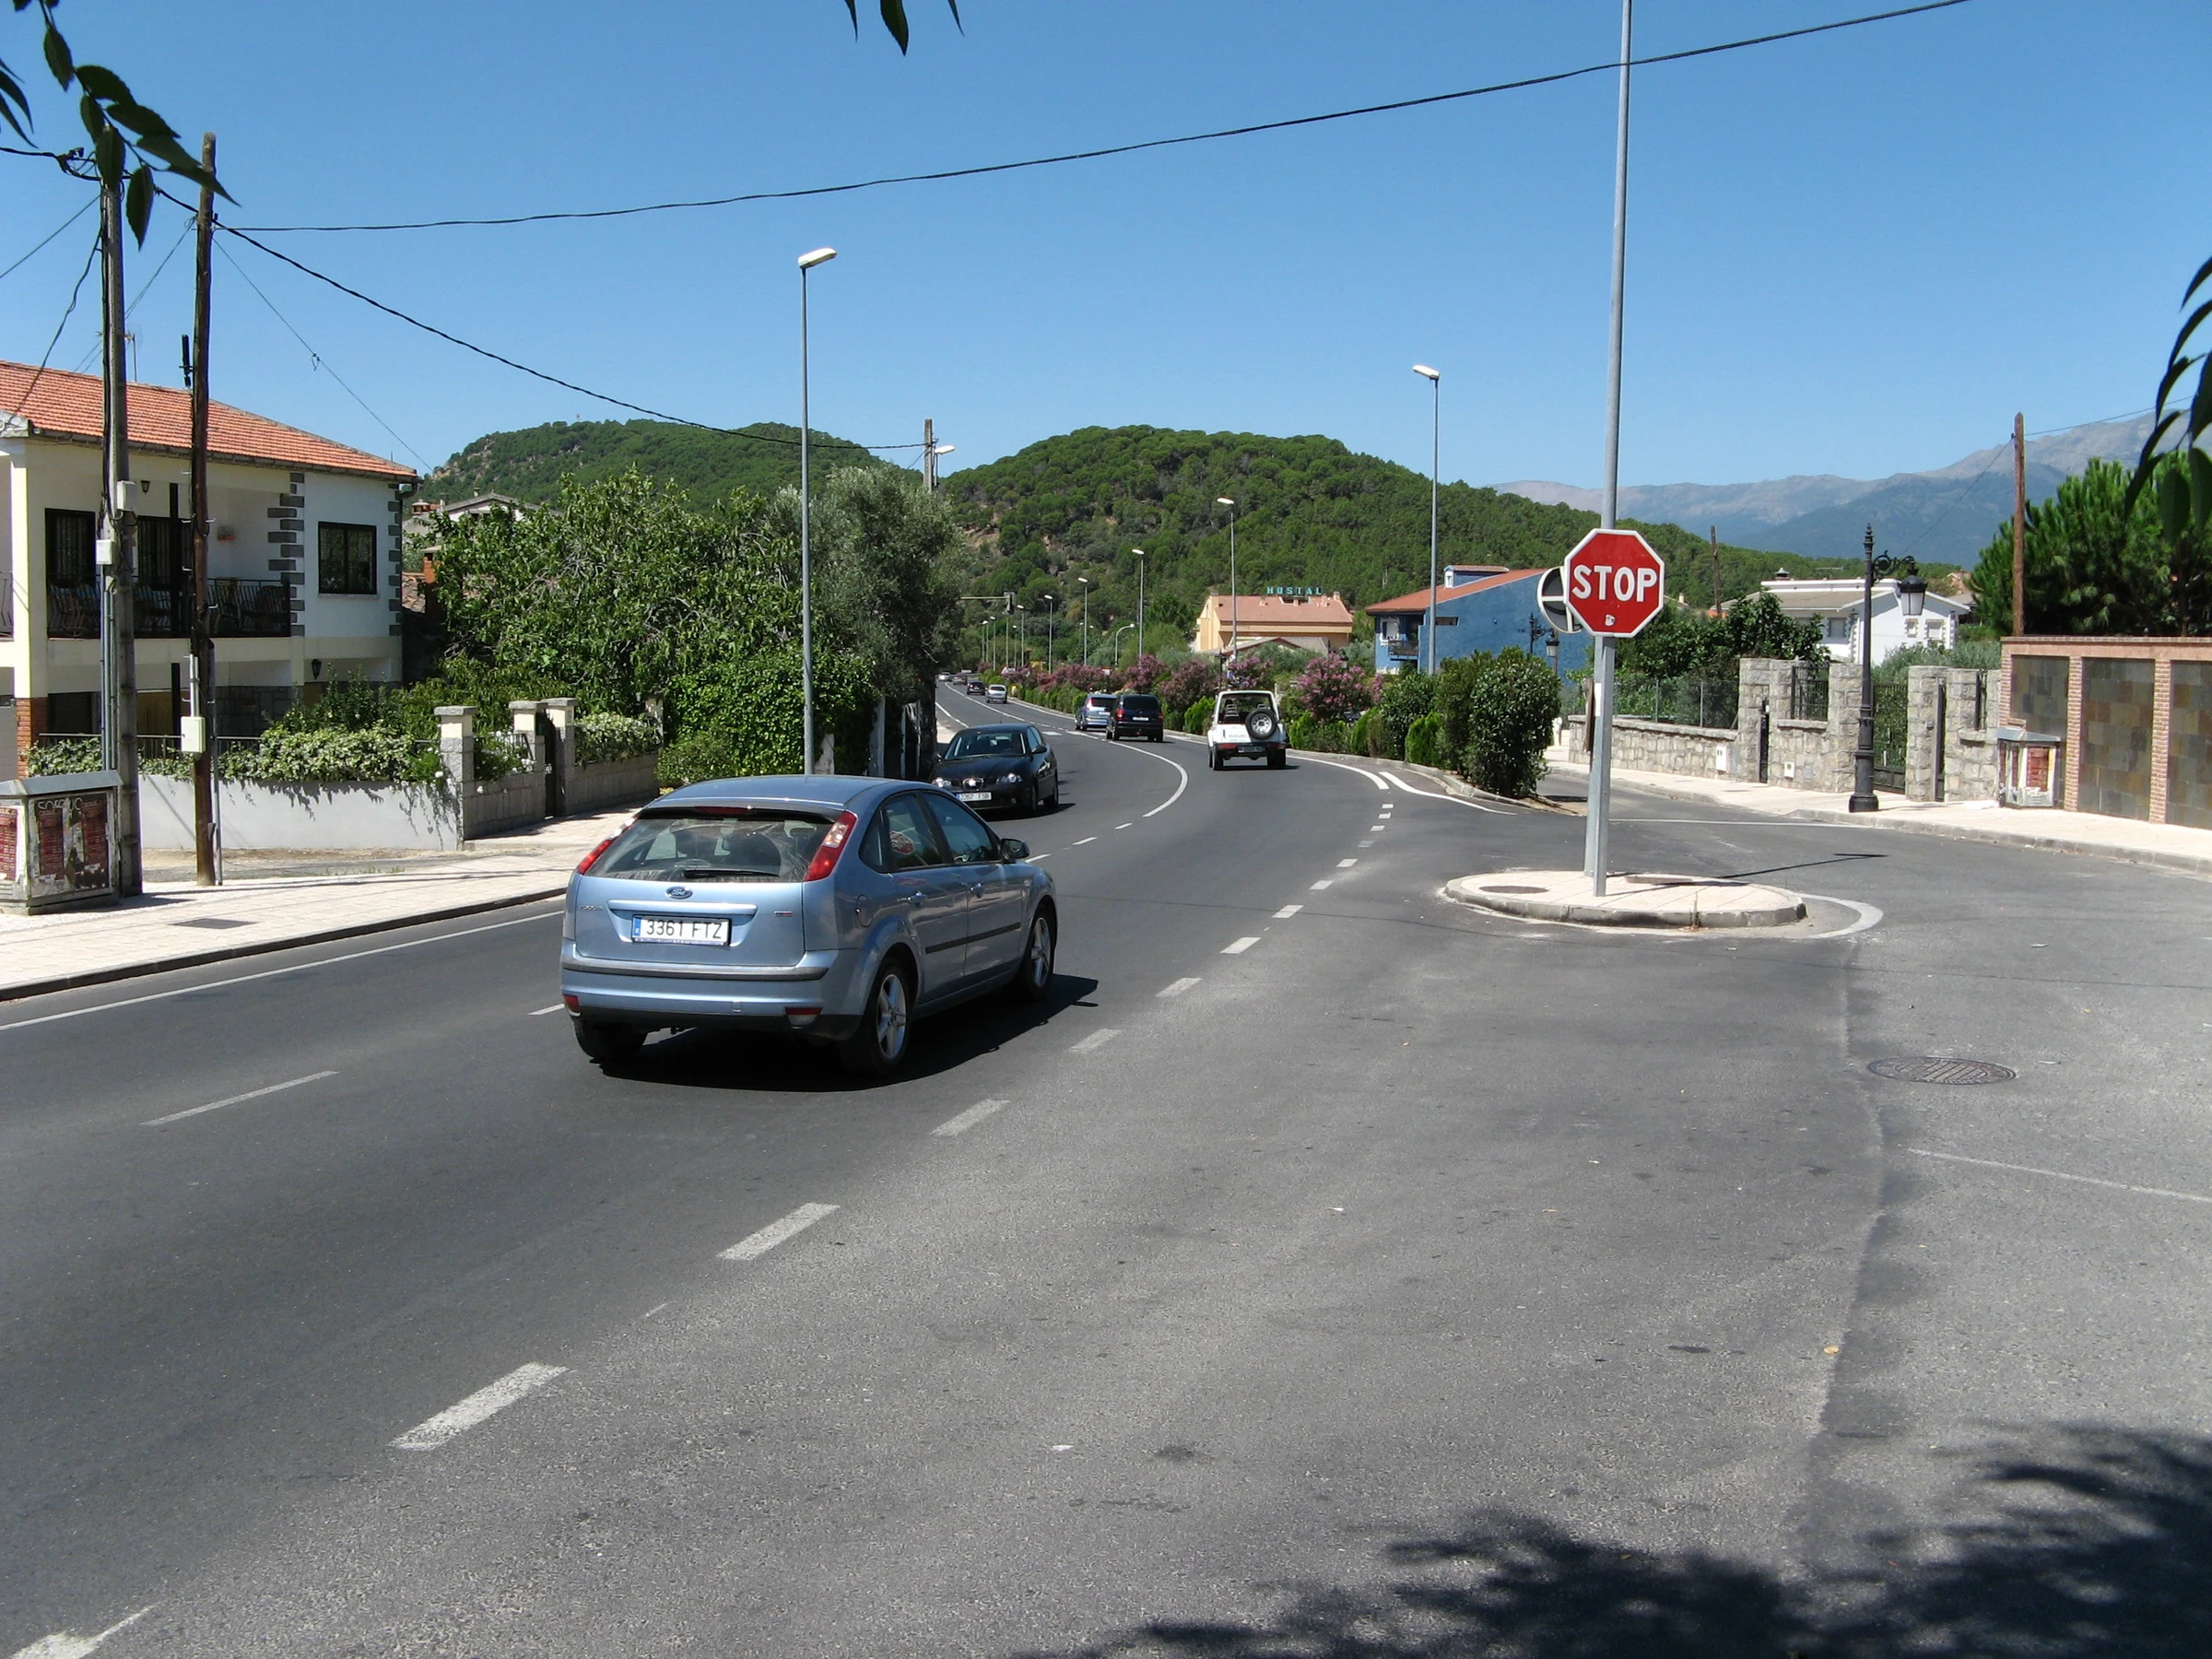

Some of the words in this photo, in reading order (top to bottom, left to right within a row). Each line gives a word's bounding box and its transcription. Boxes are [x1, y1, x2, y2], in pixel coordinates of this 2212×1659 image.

[1266, 586, 1321, 594] HOSTAL
[1571, 564, 1657, 602] STOP
[646, 919, 683, 936] 3361
[692, 921, 723, 939] FTZ
